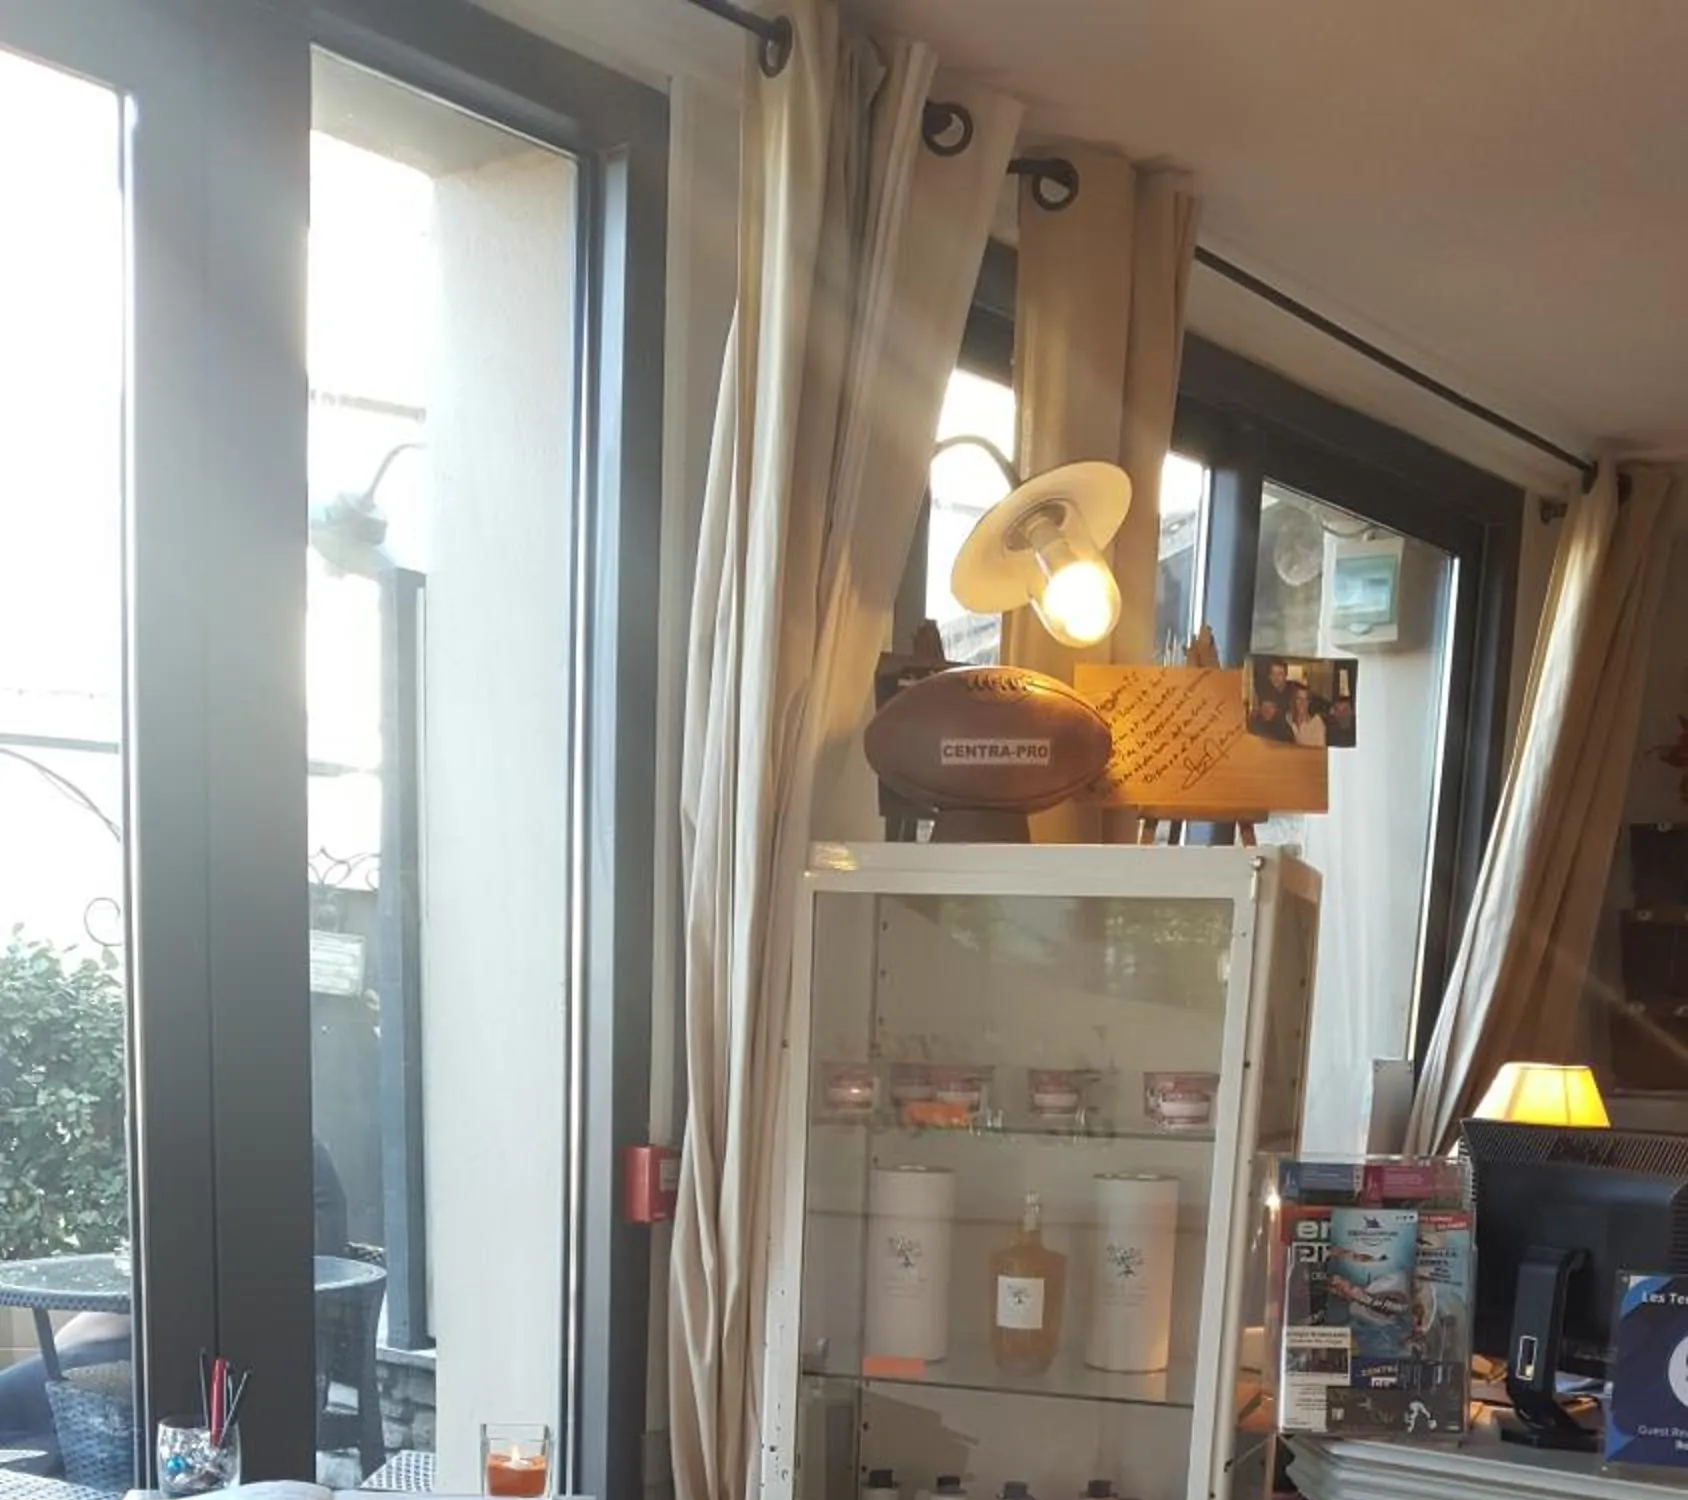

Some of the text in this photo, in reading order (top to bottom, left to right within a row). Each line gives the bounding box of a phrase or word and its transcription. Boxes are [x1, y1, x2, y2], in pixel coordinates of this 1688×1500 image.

[943, 744, 1049, 759] CENTRA-PRO
[1641, 1291, 1666, 1304] Les
[1638, 1424, 1669, 1437] Guest
